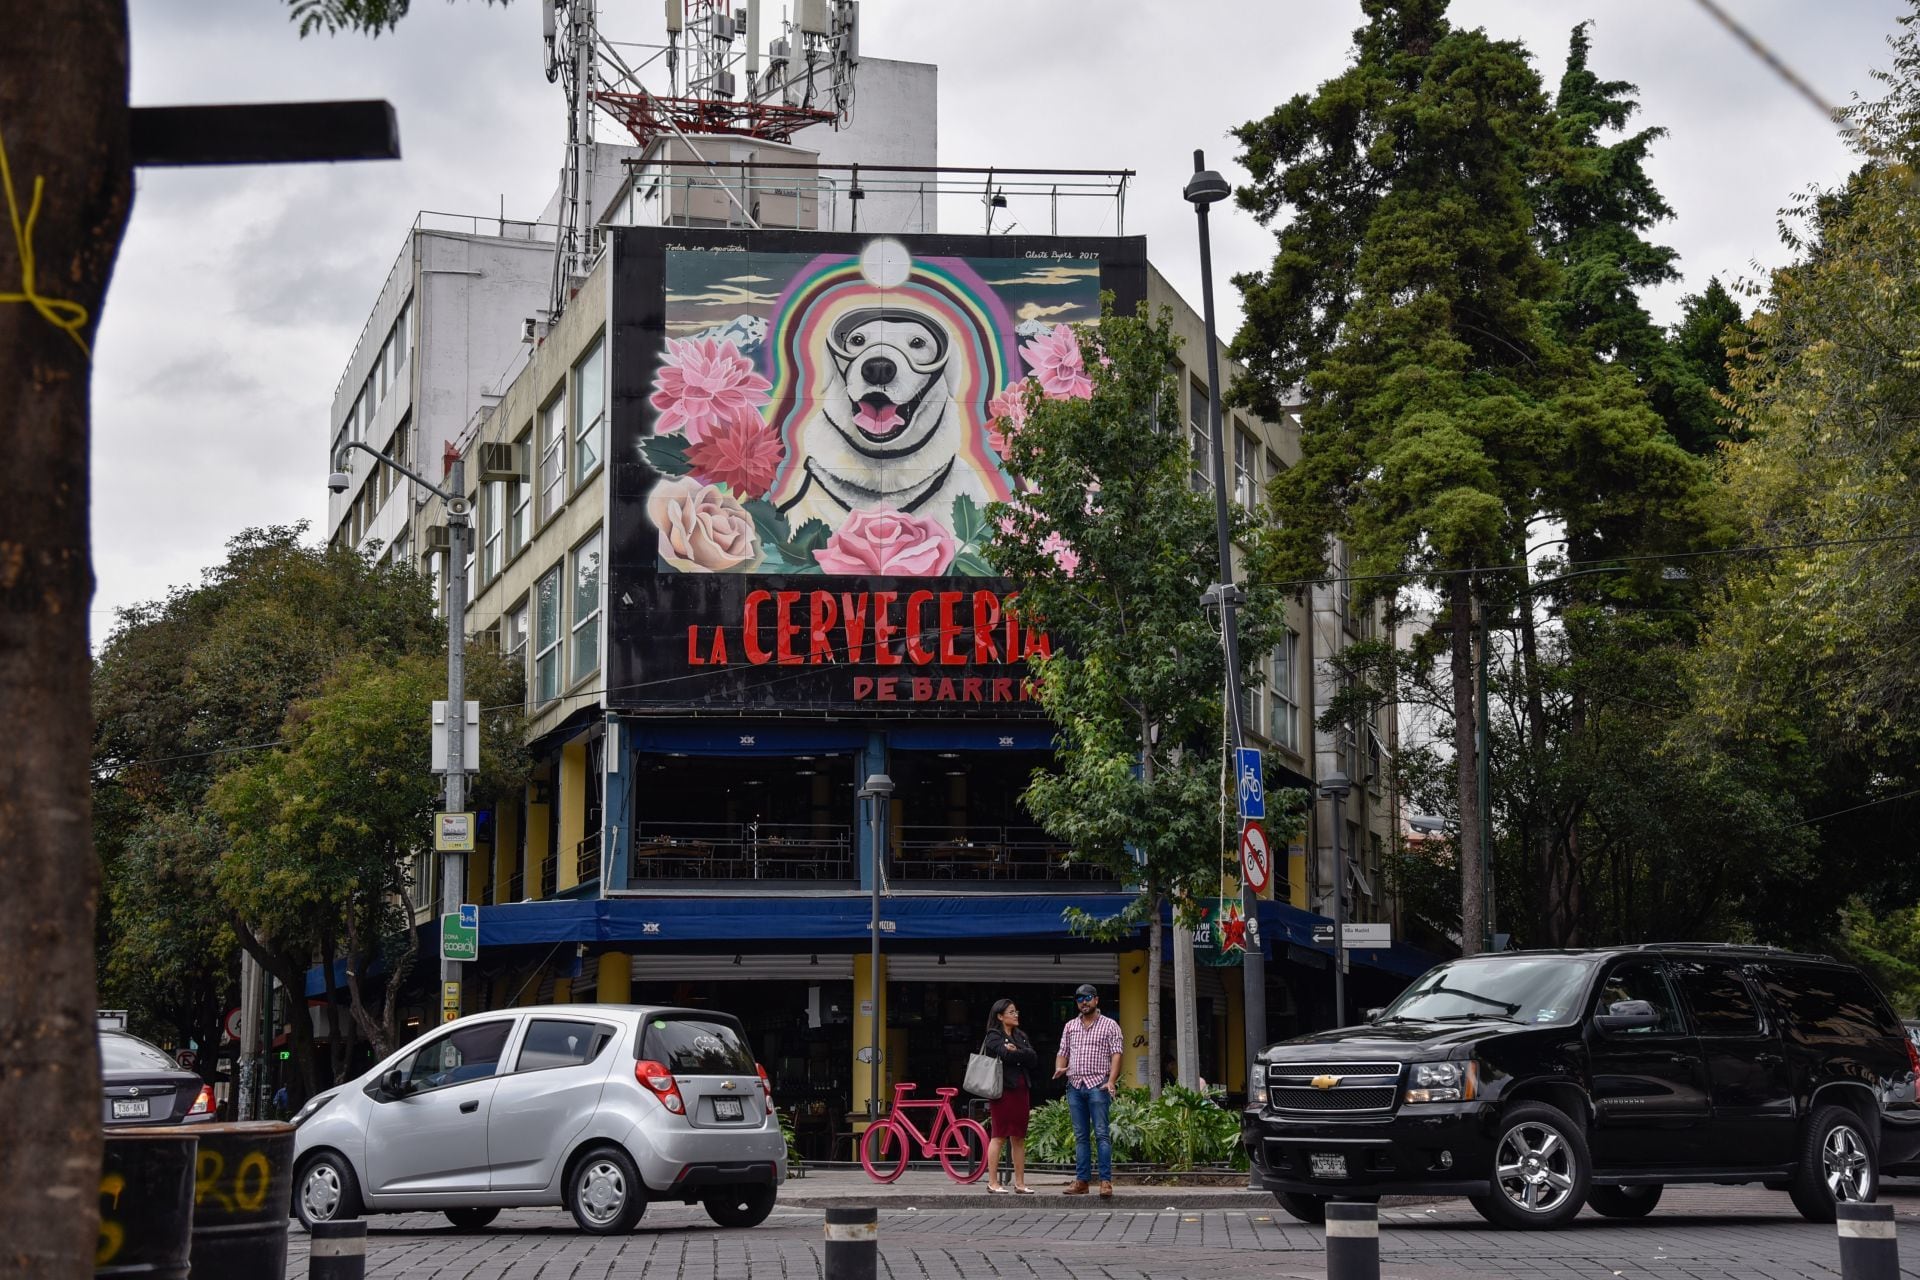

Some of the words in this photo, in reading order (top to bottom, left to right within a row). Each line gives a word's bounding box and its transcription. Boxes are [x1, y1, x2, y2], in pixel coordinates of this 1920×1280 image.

[1079, 252, 1100, 260] 2017
[687, 624, 728, 665] LA
[853, 677, 899, 702] DE
